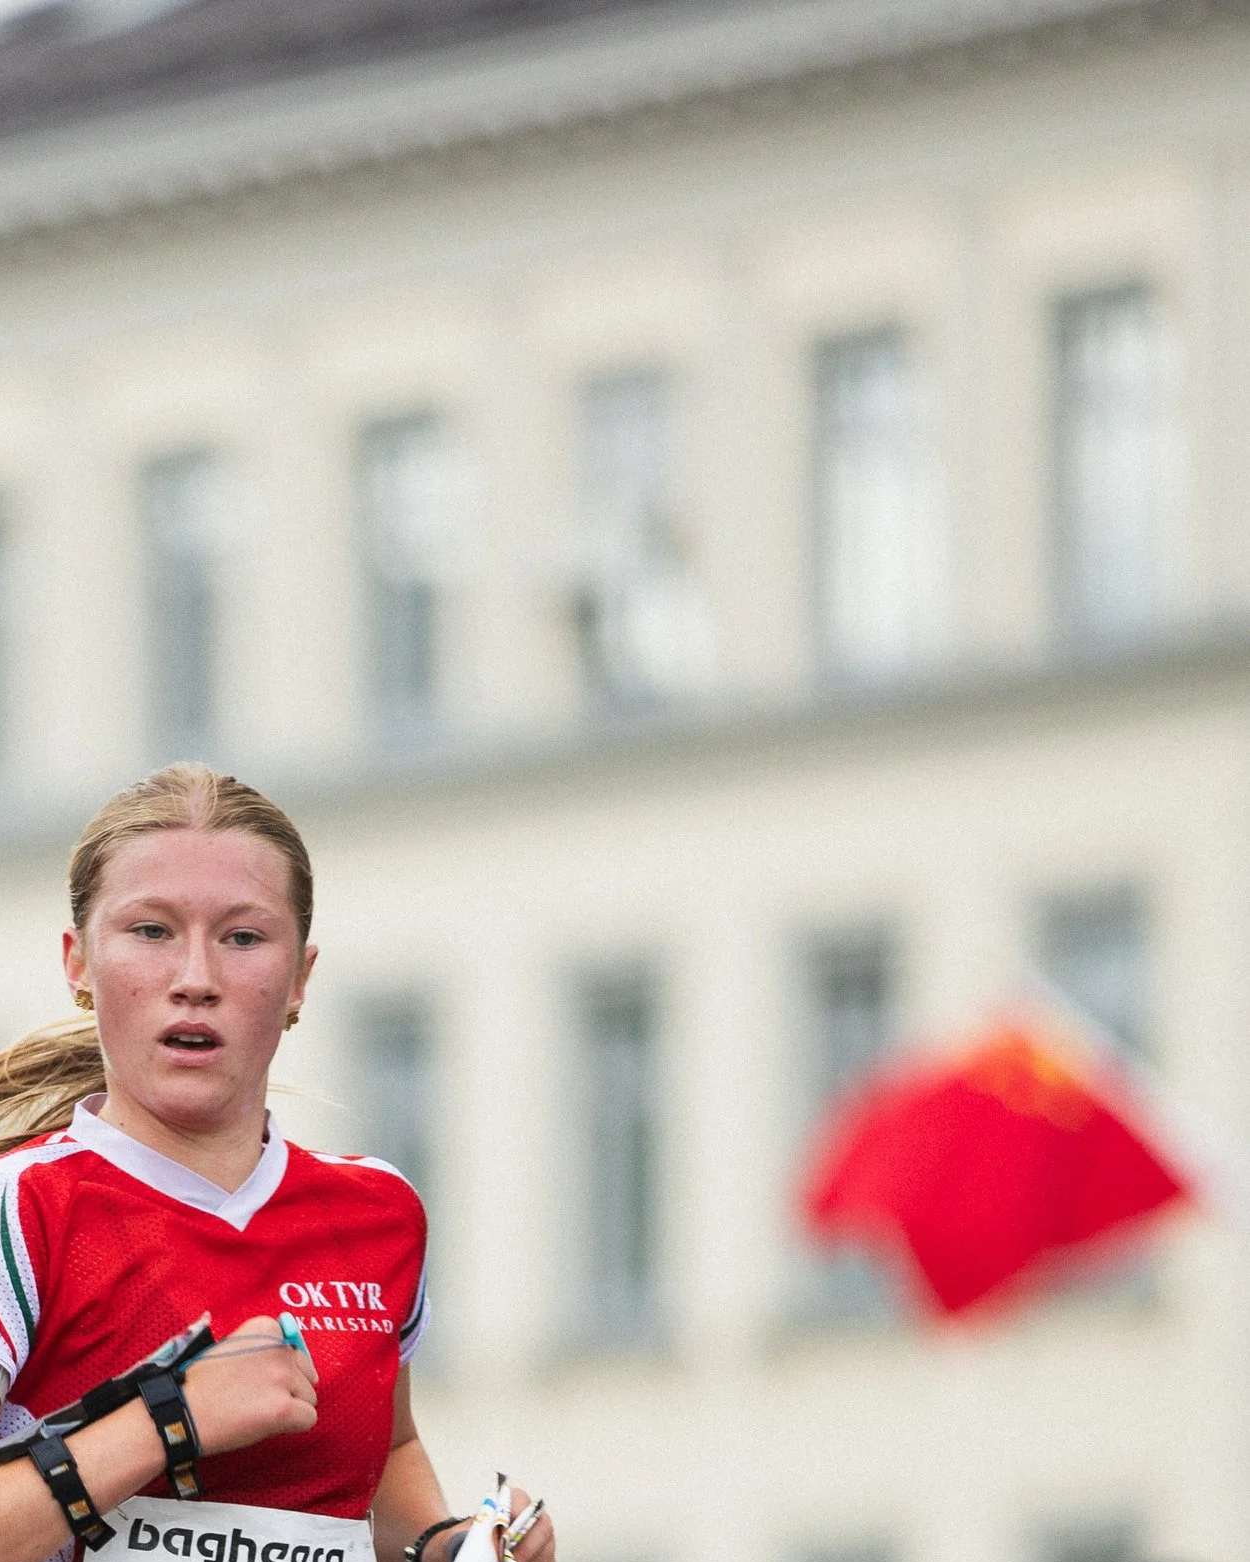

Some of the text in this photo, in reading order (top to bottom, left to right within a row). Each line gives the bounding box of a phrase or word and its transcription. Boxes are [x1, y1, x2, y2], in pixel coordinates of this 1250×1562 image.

[279, 1281, 387, 1311] OK TYR
[297, 1316, 394, 1335] KARLSTAD
